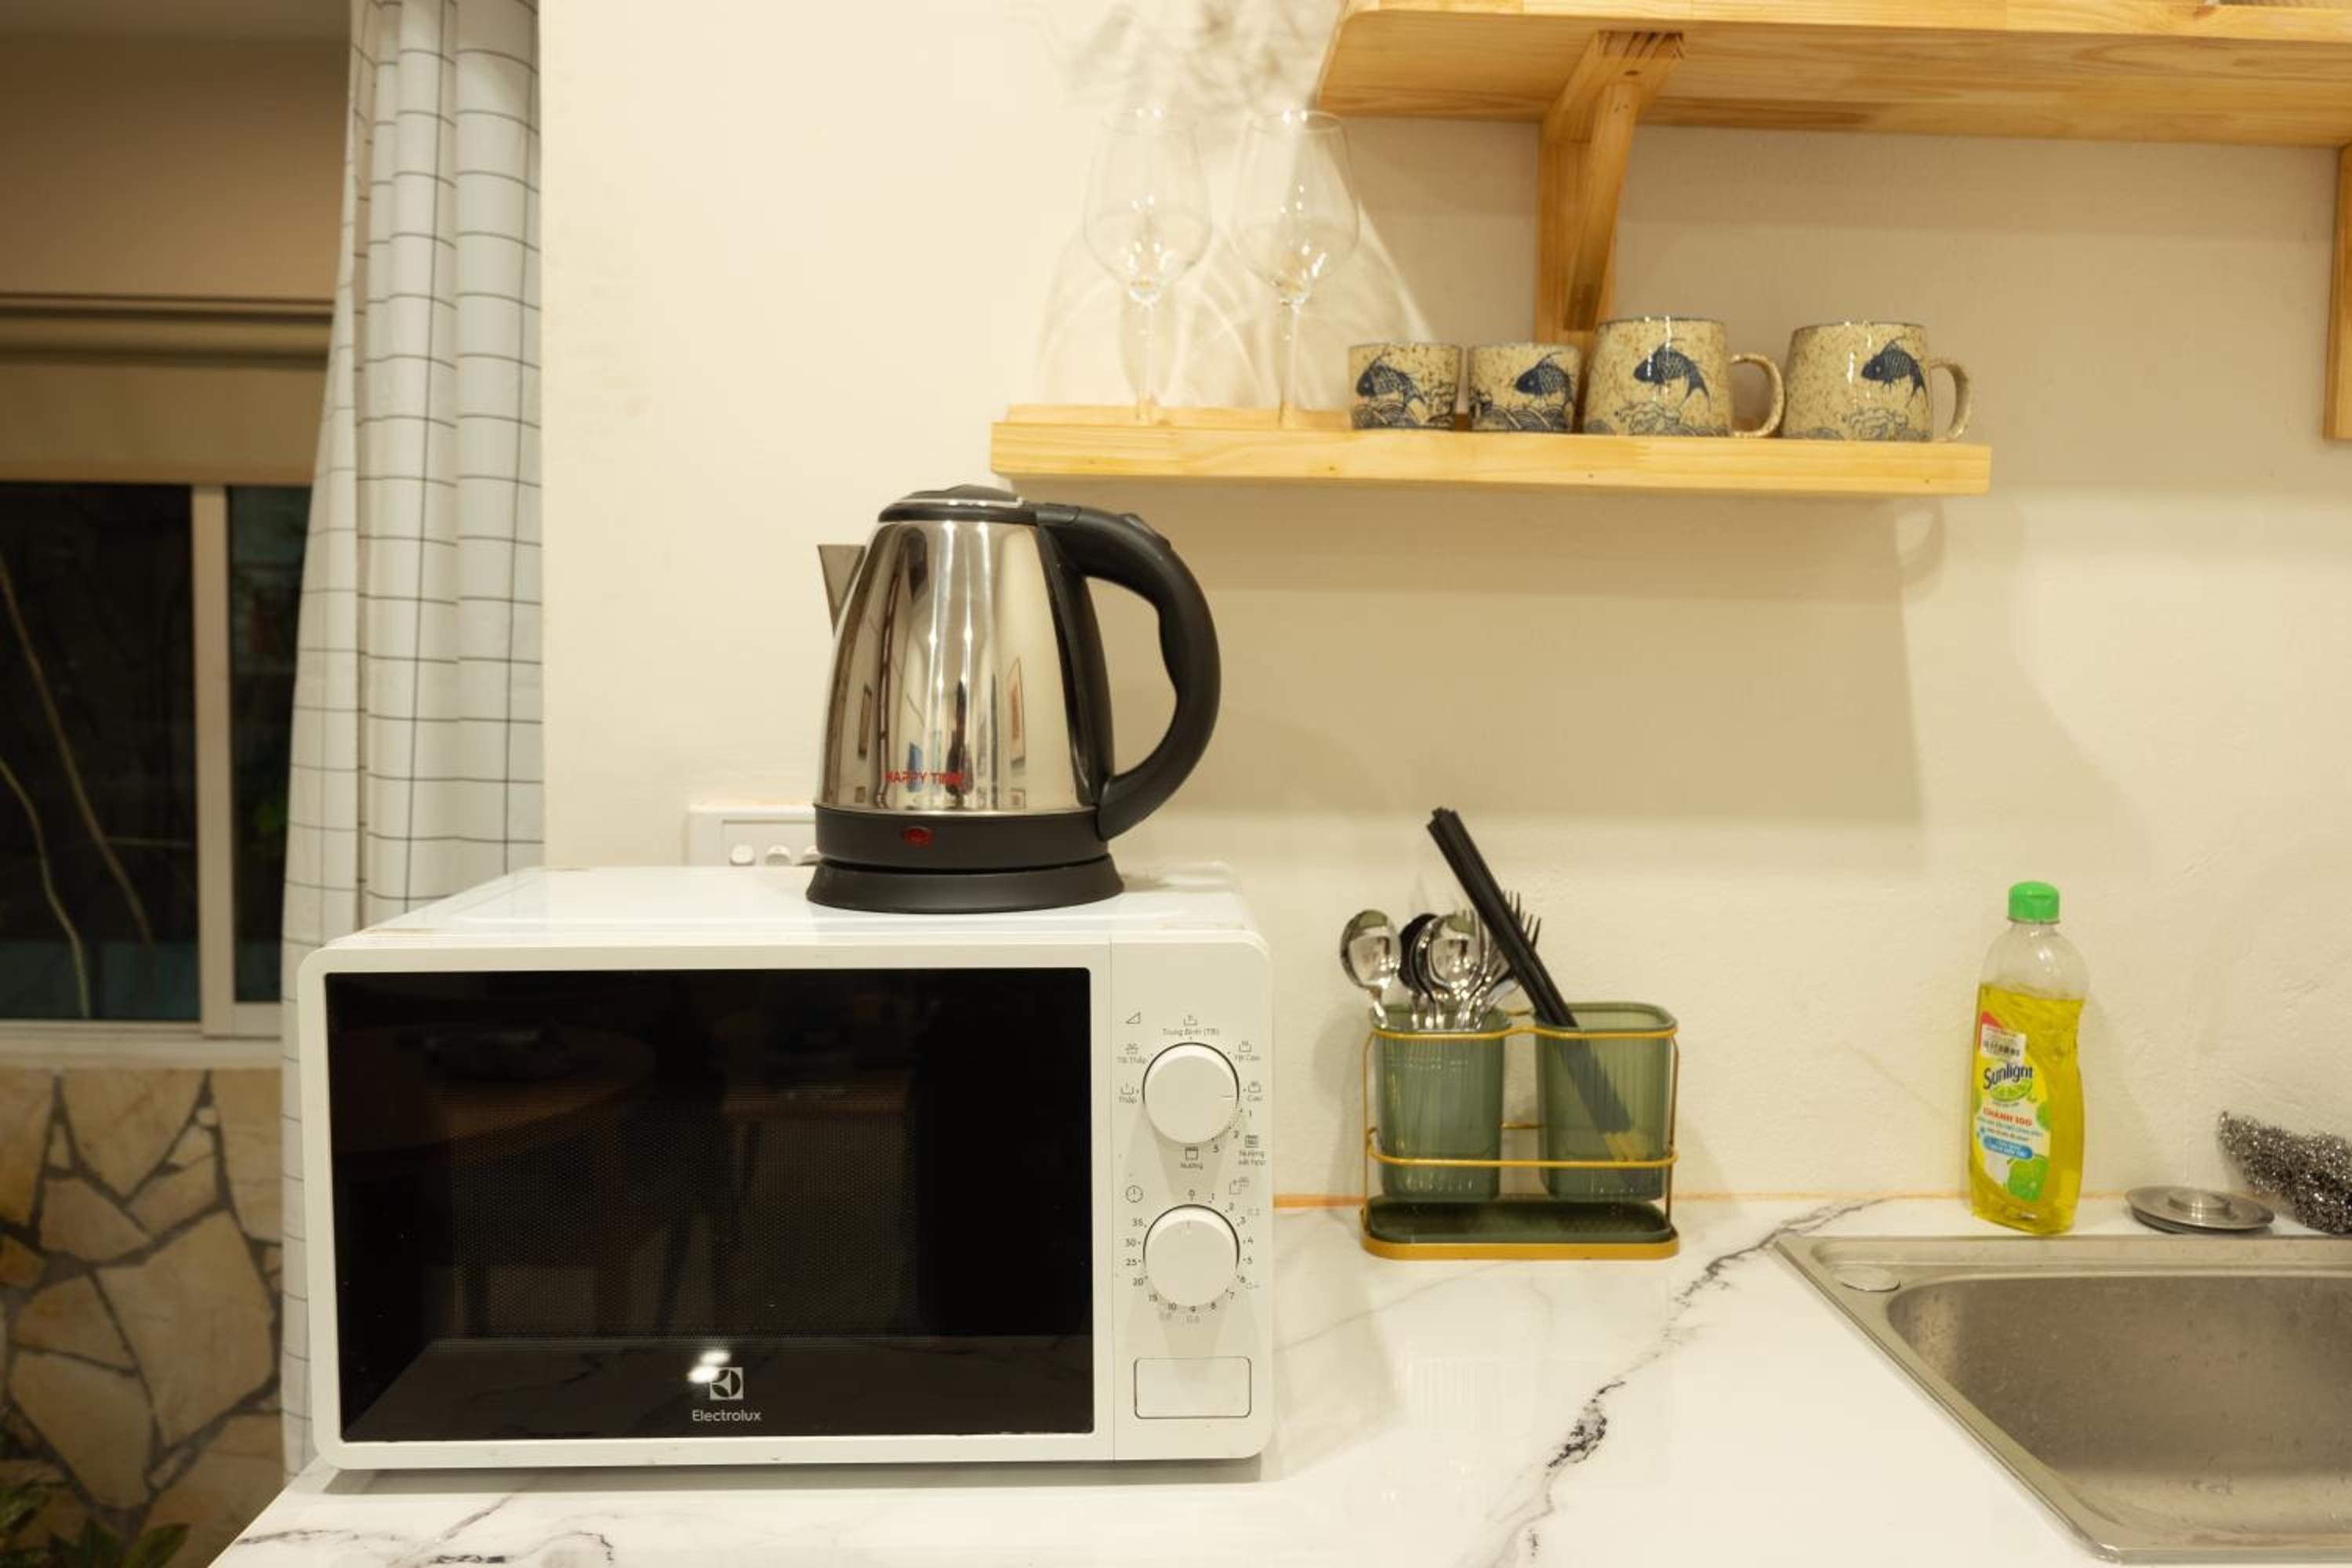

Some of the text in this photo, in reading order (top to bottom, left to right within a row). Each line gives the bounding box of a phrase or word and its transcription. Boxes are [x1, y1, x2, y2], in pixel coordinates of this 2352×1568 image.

[885, 771, 927, 784] HAPPY
[1983, 1062, 2033, 1090] Sunlight
[1233, 1130, 1240, 1139] 2
[1188, 1189, 1195, 1197] 0
[1131, 1218, 1144, 1227] 35
[1239, 1215, 1246, 1224] 3
[1133, 1277, 1144, 1286] 20
[1228, 1290, 1235, 1300] 7
[691, 1409, 762, 1422] Electrolux
